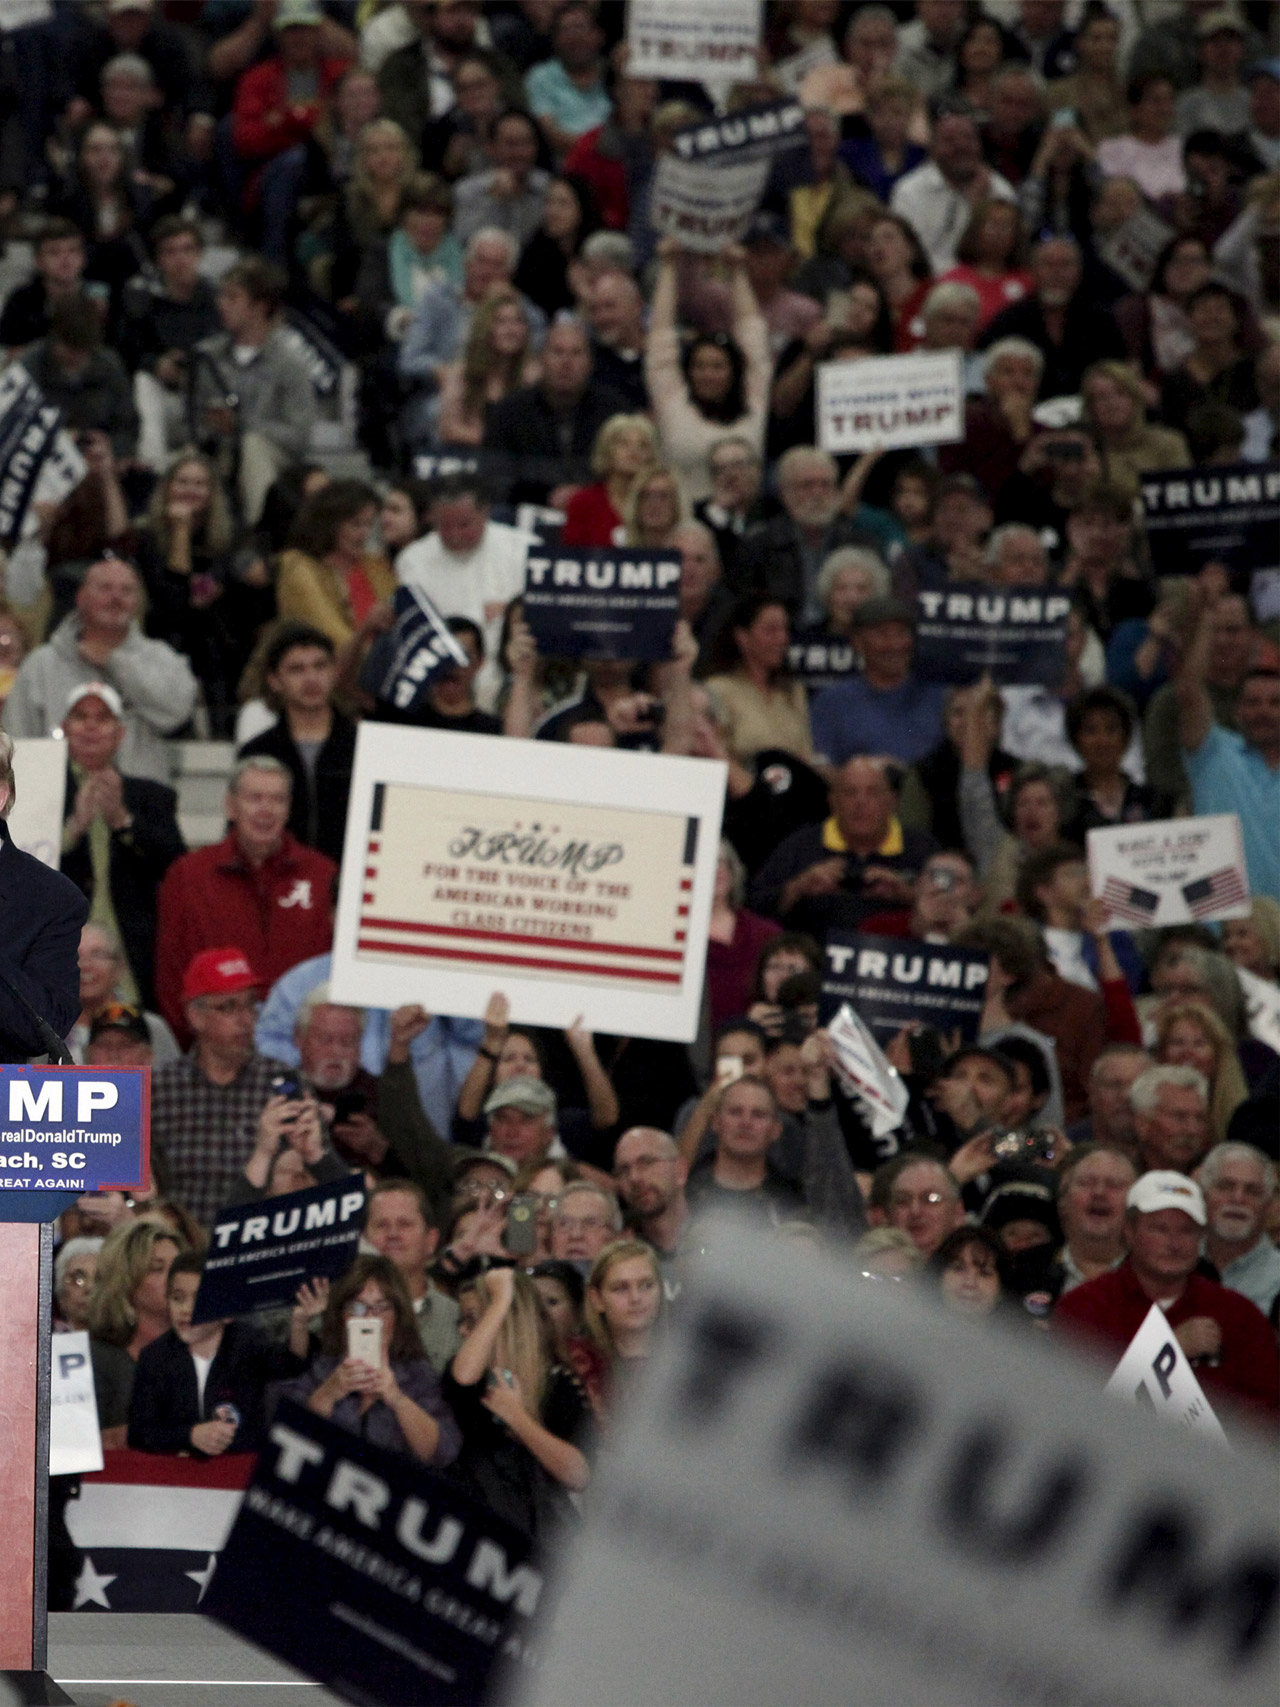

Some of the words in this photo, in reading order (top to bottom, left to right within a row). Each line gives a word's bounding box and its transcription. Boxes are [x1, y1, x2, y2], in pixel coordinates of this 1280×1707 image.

[674, 105, 805, 158] TRUMP
[832, 403, 952, 434] TRUMP
[527, 558, 682, 590] TRUMP
[920, 590, 1070, 624] TRUMP
[788, 645, 866, 672] TRU
[423, 863, 459, 880] FOR
[467, 866, 500, 884] THE
[507, 869, 558, 890] VOICE
[565, 879, 588, 895] OF
[596, 881, 631, 899] THE
[532, 898, 618, 920] WORKING
[826, 944, 990, 992] TRUMP
[51, 1153, 87, 1169] SC
[34, 1178, 85, 1189] AGAIN!
[214, 1191, 365, 1249] TRUMP
[665, 1302, 1280, 1677] TRUM
[270, 1423, 546, 1618] TRUM
